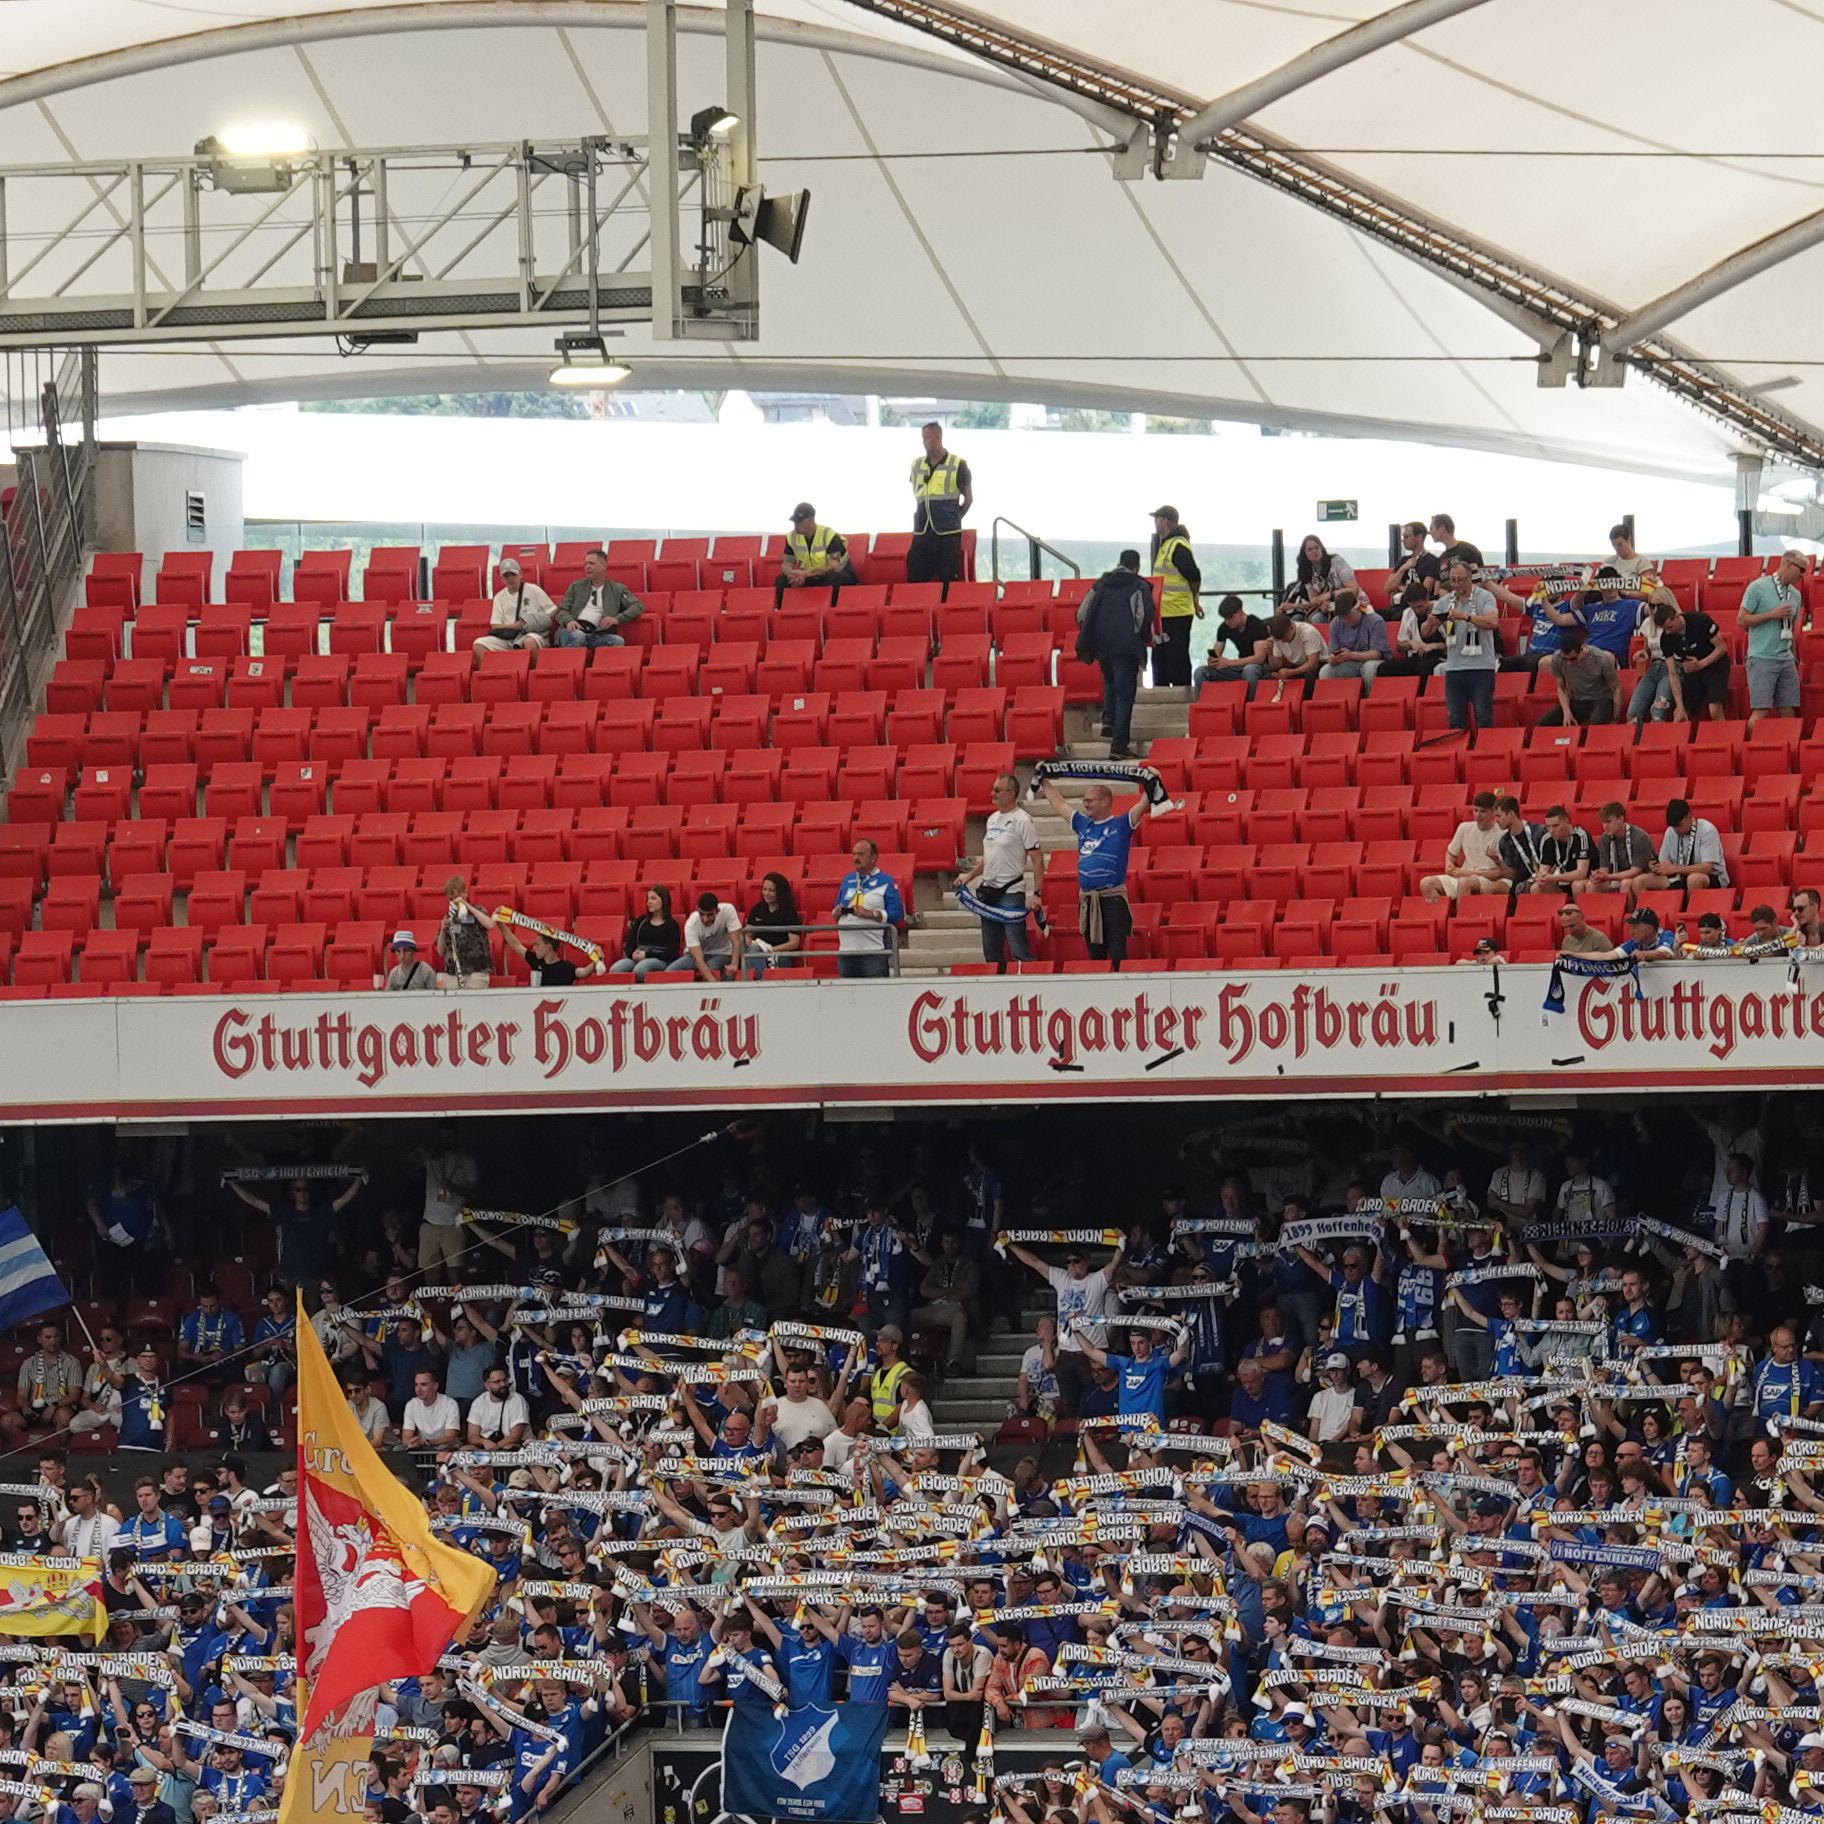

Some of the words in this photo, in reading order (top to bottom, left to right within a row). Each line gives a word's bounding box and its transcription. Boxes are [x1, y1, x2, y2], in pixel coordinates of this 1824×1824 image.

[908, 990, 1206, 1070] Stuttgarter
[1217, 984, 1441, 1063] Hofbräu
[211, 1002, 520, 1093] Stuttgarter
[533, 996, 764, 1080] Hofbräu
[1284, 1222, 1313, 1239] 1899
[774, 1321, 806, 1337] NORD
[582, 1397, 614, 1411] NORD
[631, 1395, 667, 1410] BADEN
[1382, 1426, 1412, 1440] NORD
[1429, 1424, 1472, 1438] BADEN
[908, 1433, 976, 1448] HOFFENHEIM
[1548, 1511, 1582, 1523] NORD
[1601, 1510, 1645, 1522] BADEN
[601, 1540, 637, 1554] NORD
[656, 1537, 702, 1550] BADEN
[897, 1544, 939, 1560] BADEN
[1565, 1549, 1645, 1567] HOFFENHEIM
[748, 1574, 787, 1587] NORD
[807, 1572, 854, 1585] BADEN
[994, 1606, 1033, 1620] NORD
[1056, 1602, 1101, 1615] BADEN
[1568, 1650, 1603, 1668] NORD
[100, 1660, 130, 1675] NORD
